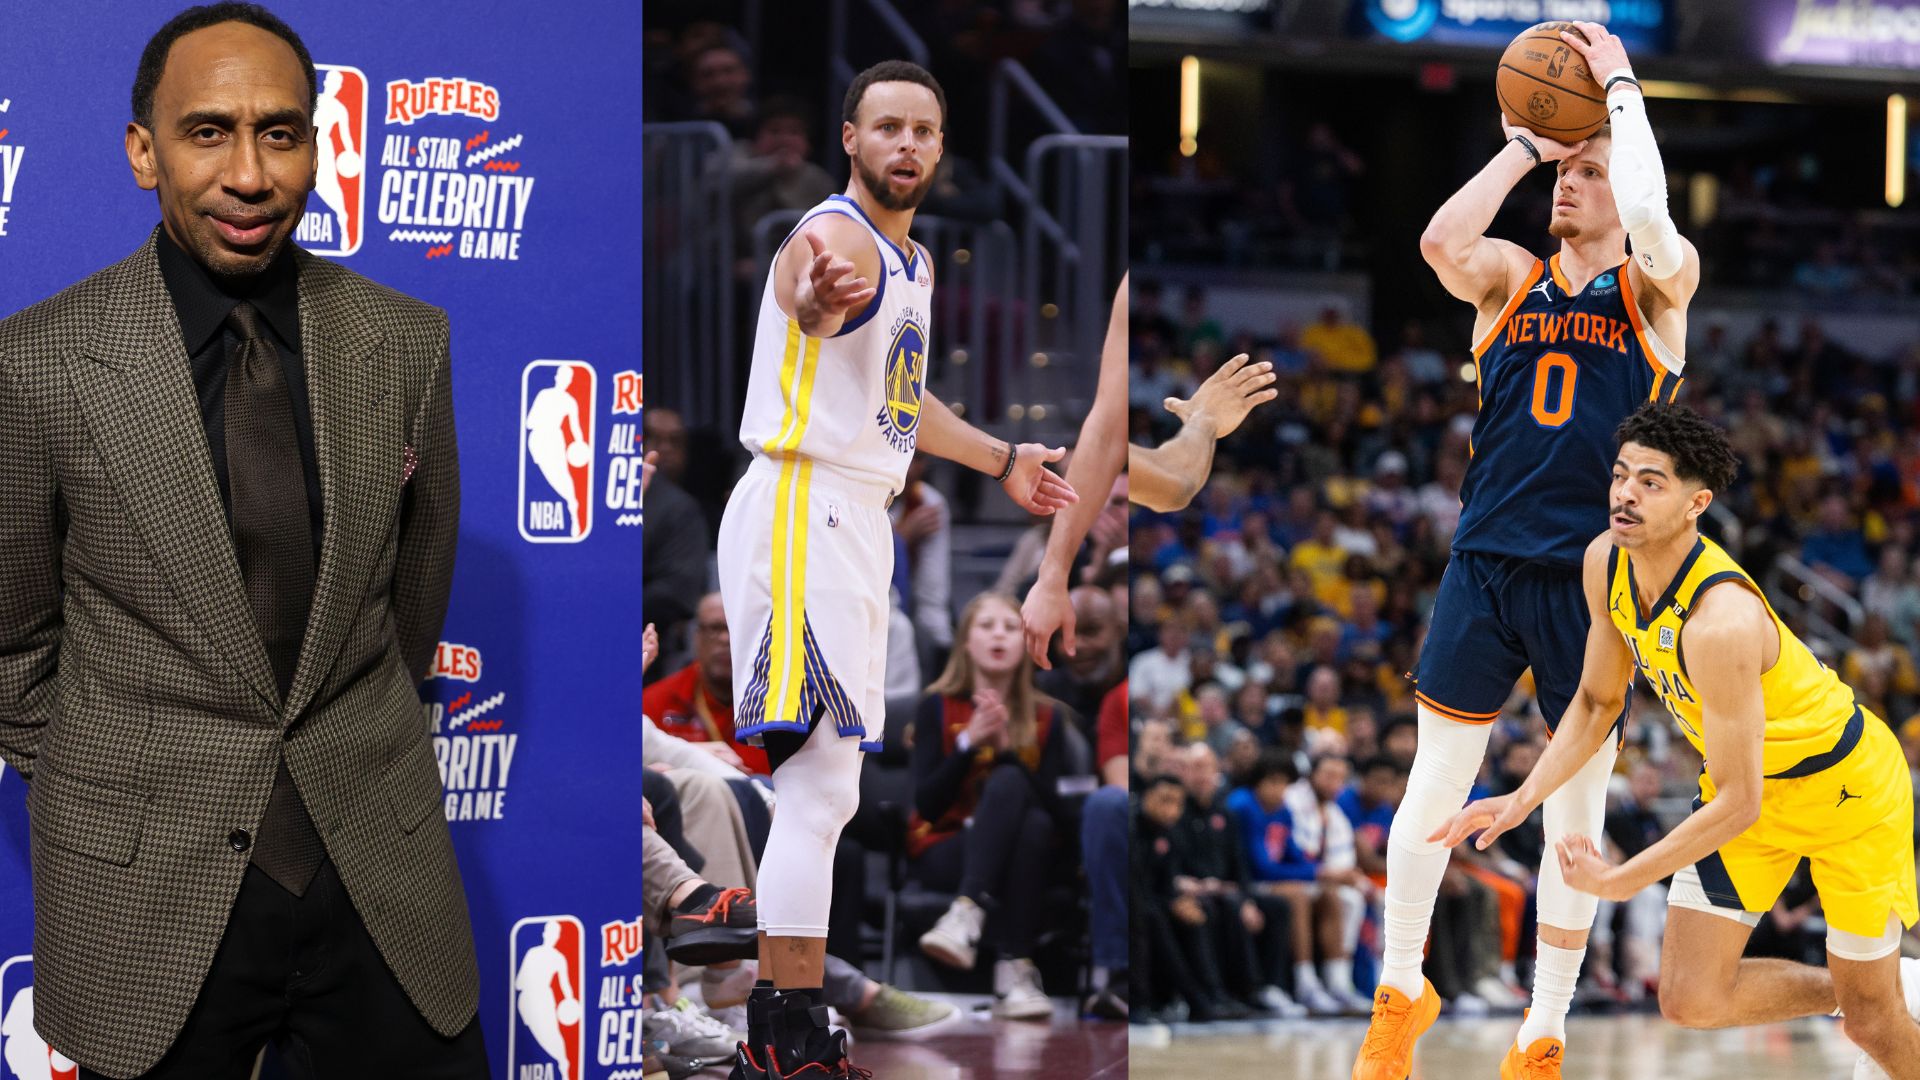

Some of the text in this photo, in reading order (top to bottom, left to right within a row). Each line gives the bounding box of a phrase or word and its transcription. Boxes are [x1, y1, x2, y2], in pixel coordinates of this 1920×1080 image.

[386, 78, 499, 125] RUFFLES
[378, 170, 534, 230] CELEBRITY
[296, 212, 333, 242] NBA
[459, 231, 522, 260] GAME
[890, 306, 914, 336] GOLDEN
[910, 351, 923, 384] 30
[1529, 351, 1580, 430] 0
[876, 404, 917, 453] WARRIO
[529, 501, 565, 530] NBA
[445, 791, 506, 821] GAME
[519, 1062, 555, 1080] NBA
